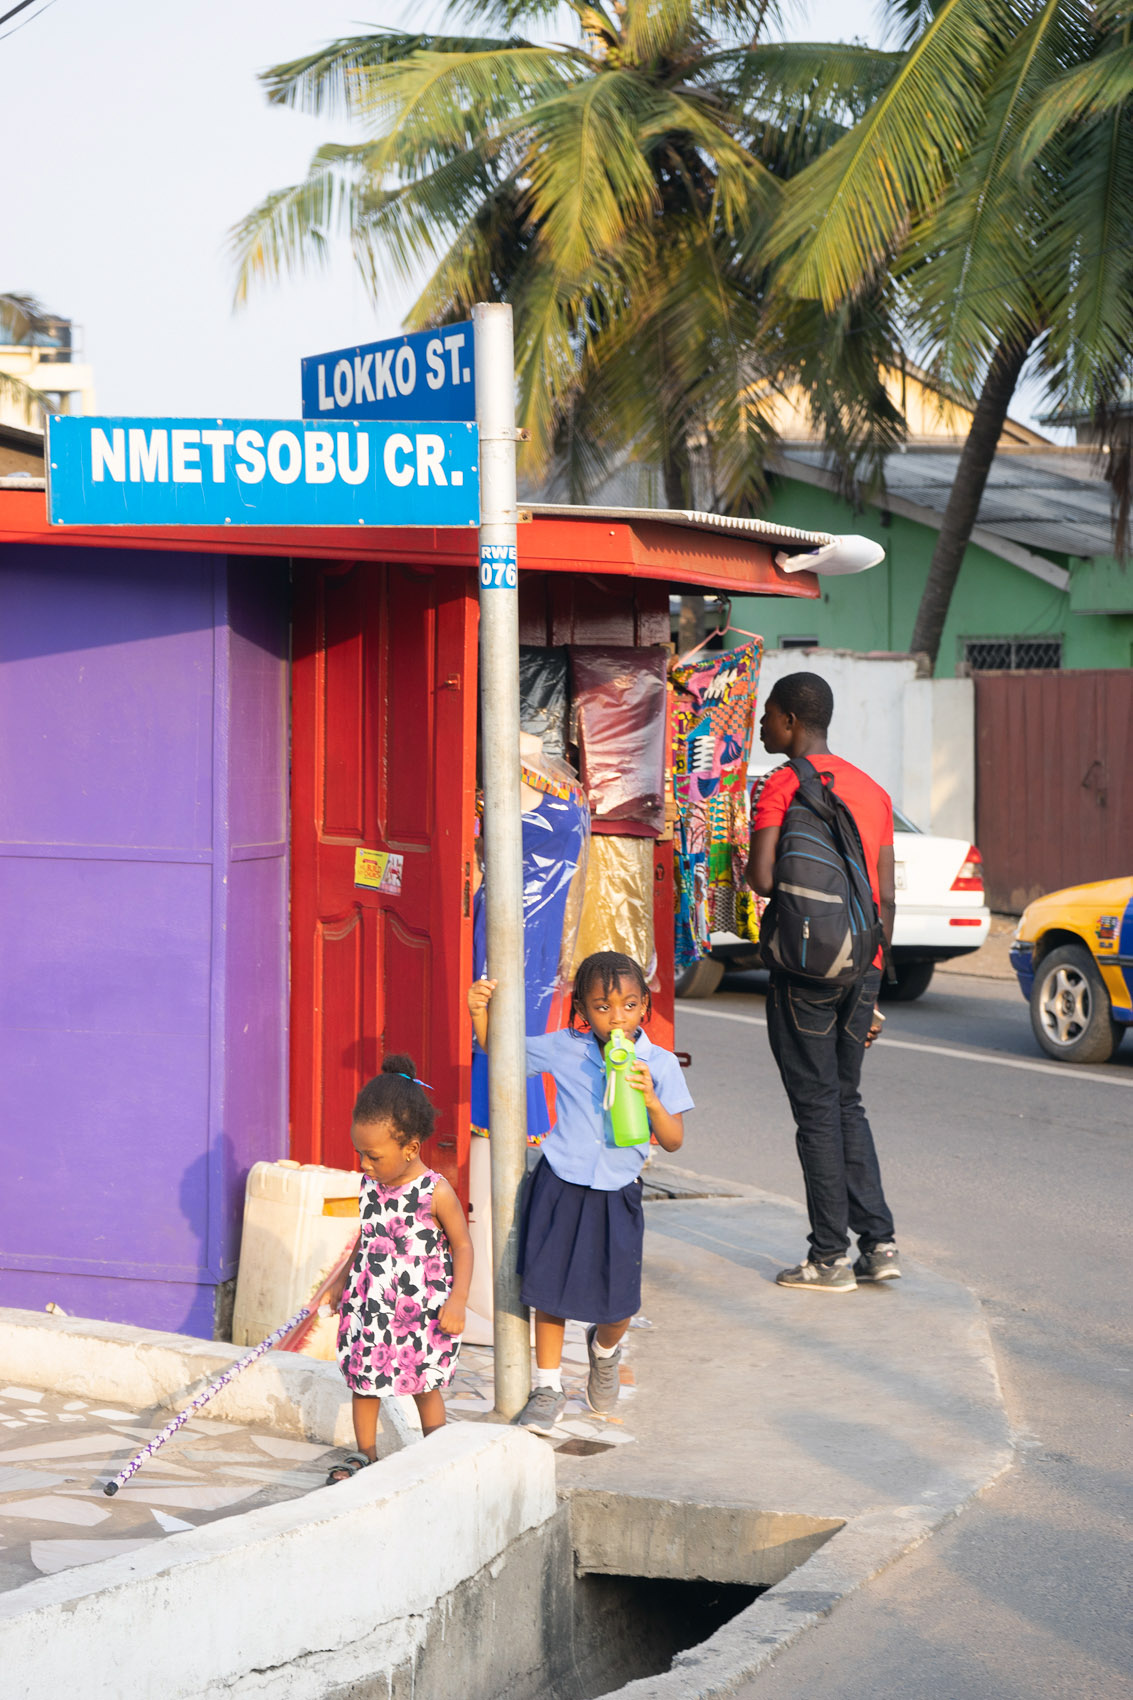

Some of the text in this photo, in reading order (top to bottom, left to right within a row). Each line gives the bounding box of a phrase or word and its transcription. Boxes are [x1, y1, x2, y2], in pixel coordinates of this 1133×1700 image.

[317, 333, 471, 411] LOKKO ST.
[90, 428, 463, 487] NMETSOBU CR.
[481, 546, 517, 560] RWE
[481, 563, 516, 587] 076
